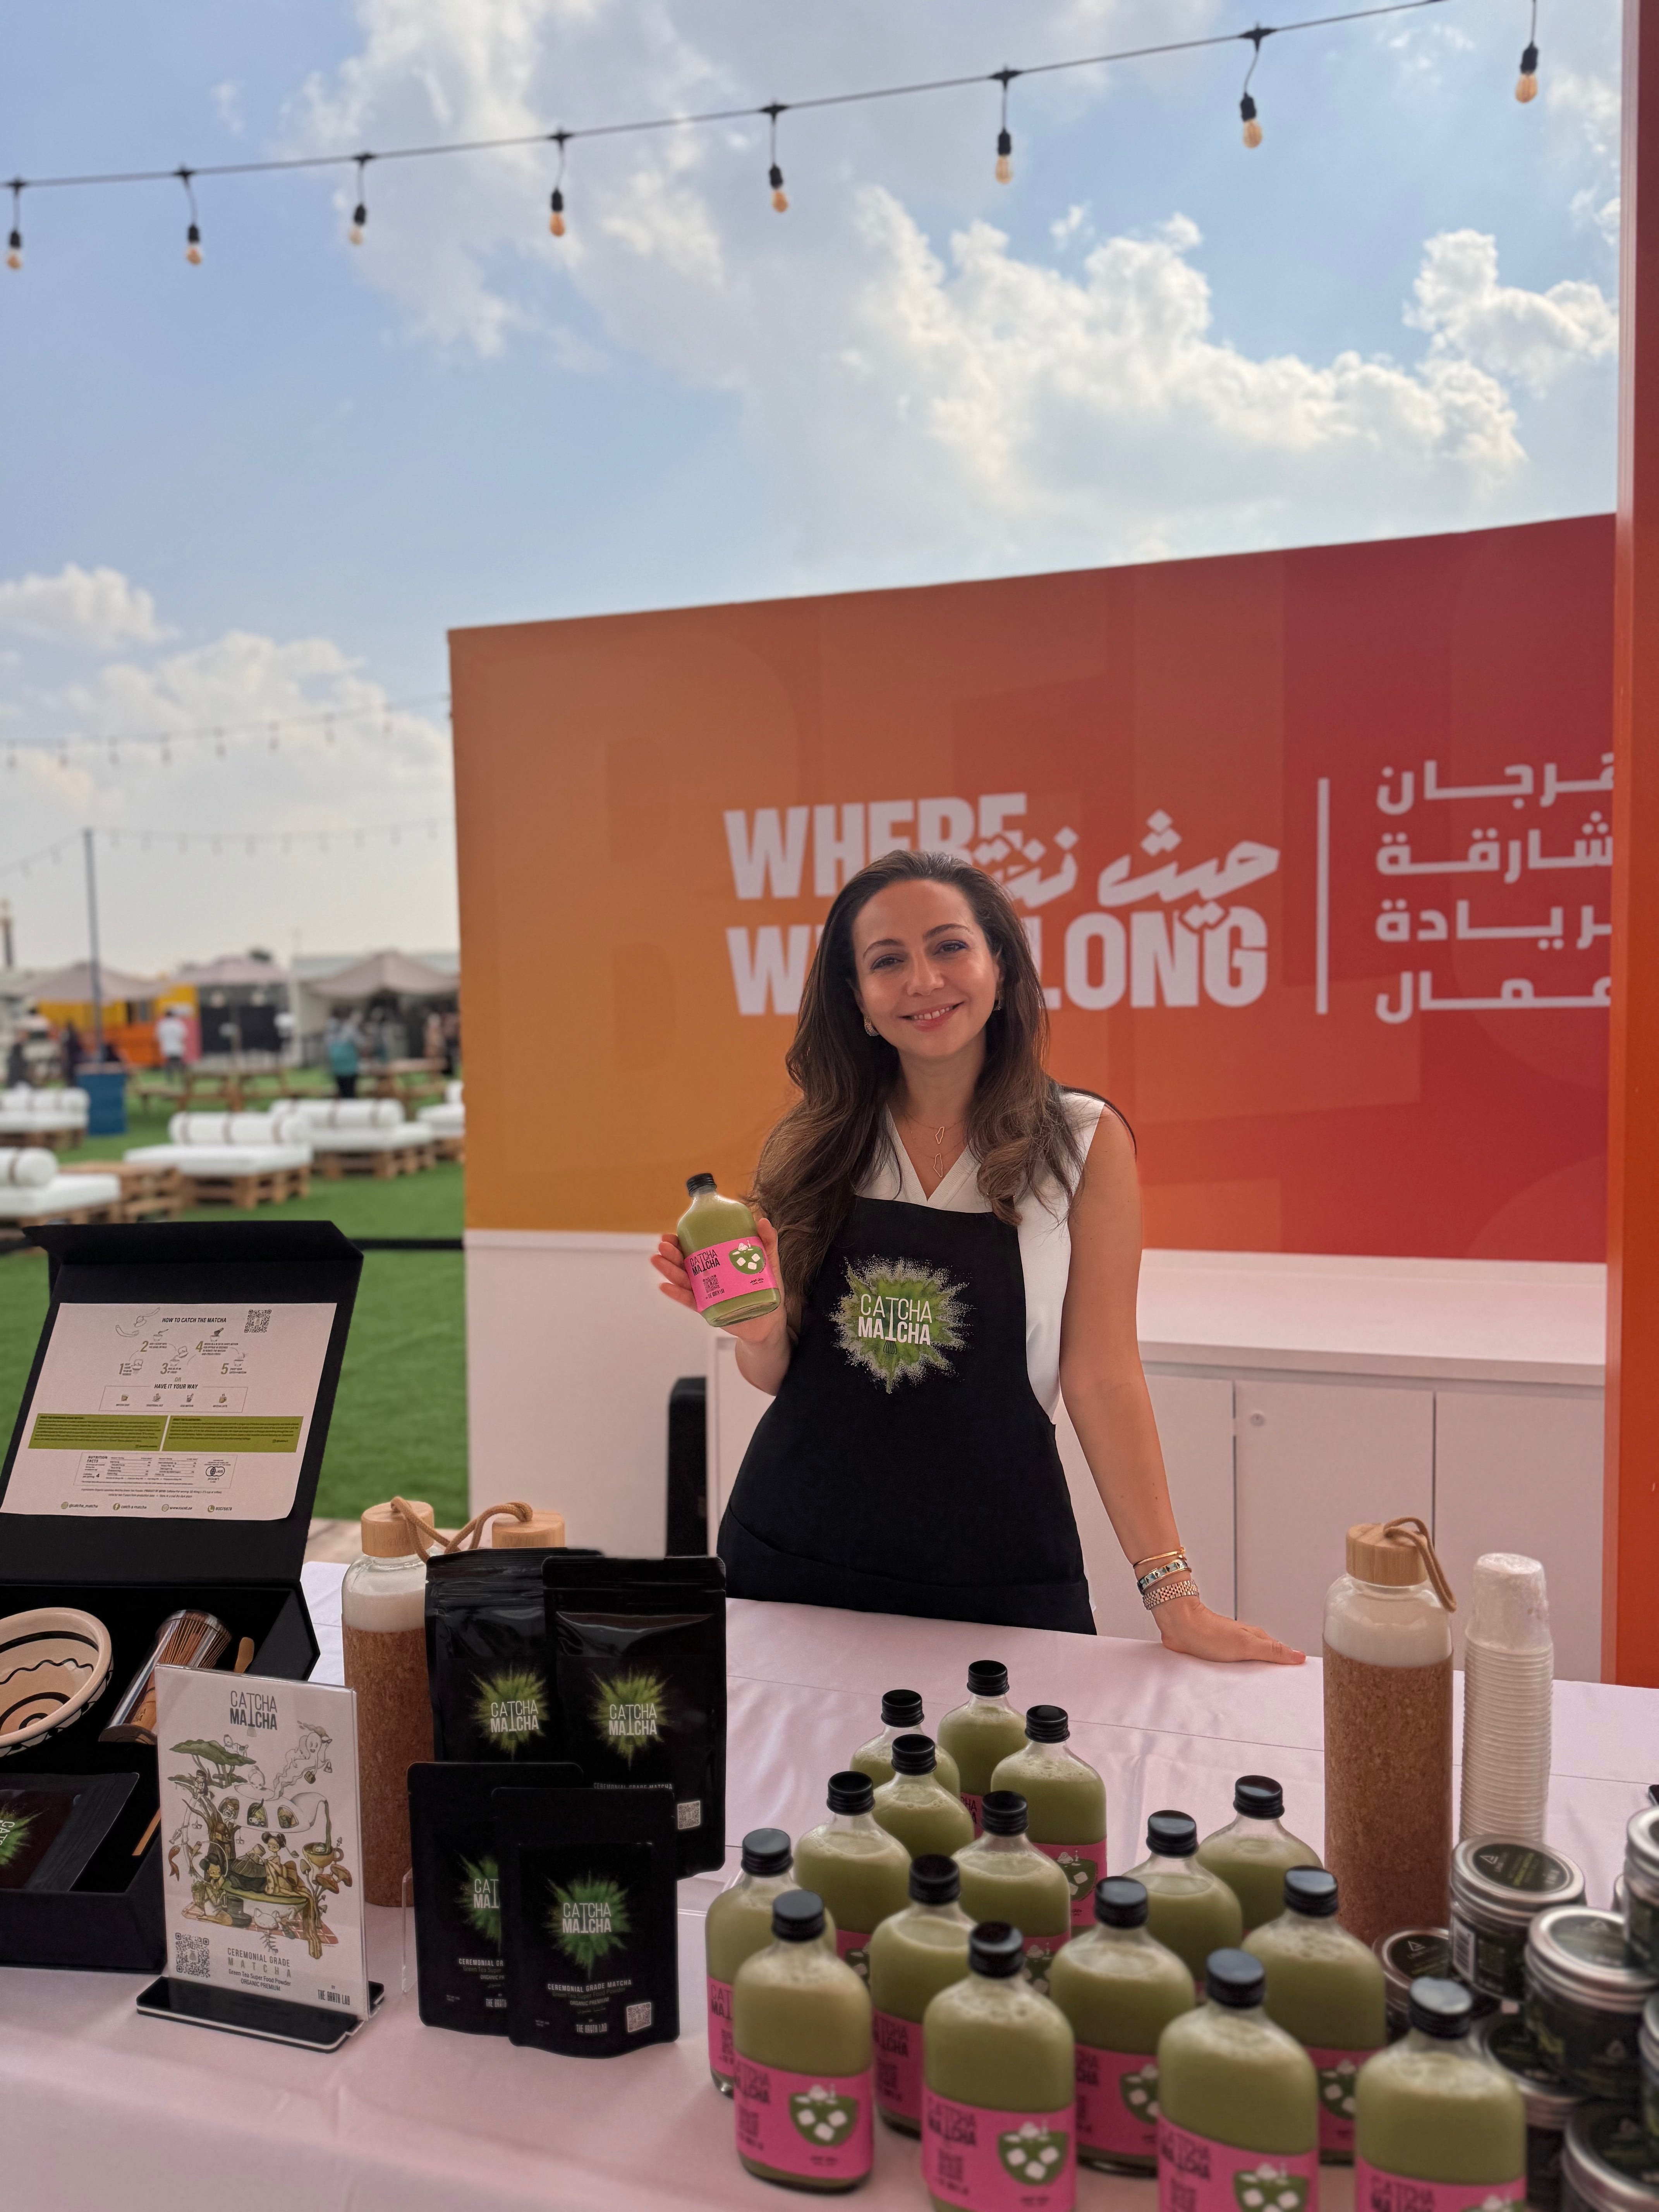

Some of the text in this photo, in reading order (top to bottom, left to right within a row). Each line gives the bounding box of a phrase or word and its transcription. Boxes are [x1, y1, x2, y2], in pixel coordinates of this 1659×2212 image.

[1376, 899, 1612, 950] ريادة
[725, 924, 824, 1015] W
[690, 1249, 718, 1267] CATCHA
[692, 1258, 720, 1276] MATCHA
[860, 1293, 932, 1323] CATCHA
[858, 1316, 930, 1345] MATCHA
[140, 1341, 149, 1352] 2
[196, 1341, 204, 1352] 4
[119, 1363, 124, 1374] 1
[160, 1363, 168, 1374] 3
[221, 1363, 229, 1374] 5
[231, 1690, 277, 1713] CATCHA
[491, 1700, 539, 1717] CATCHA
[230, 1708, 277, 1730] MATCHA
[610, 1703, 657, 1719] CATCHA
[490, 1715, 539, 1733] MATCHA
[609, 1719, 657, 1735] MATCHA
[475, 1879, 499, 1893] CAT
[474, 1894, 500, 1908] MAT
[563, 1902, 611, 1917] CATCHA
[563, 1918, 612, 1933] MATCHA
[228, 1948, 290, 1967] CEREMONIAL GRADE
[459, 1958, 494, 1966] CEREMONIAL
[241, 1978, 280, 1991] ORGANIC PREMIUM
[548, 1979, 632, 1992] CEREMONIAL GRADE MATCHA
[711, 1985, 732, 2002] CAT
[711, 1999, 732, 2020] MAT
